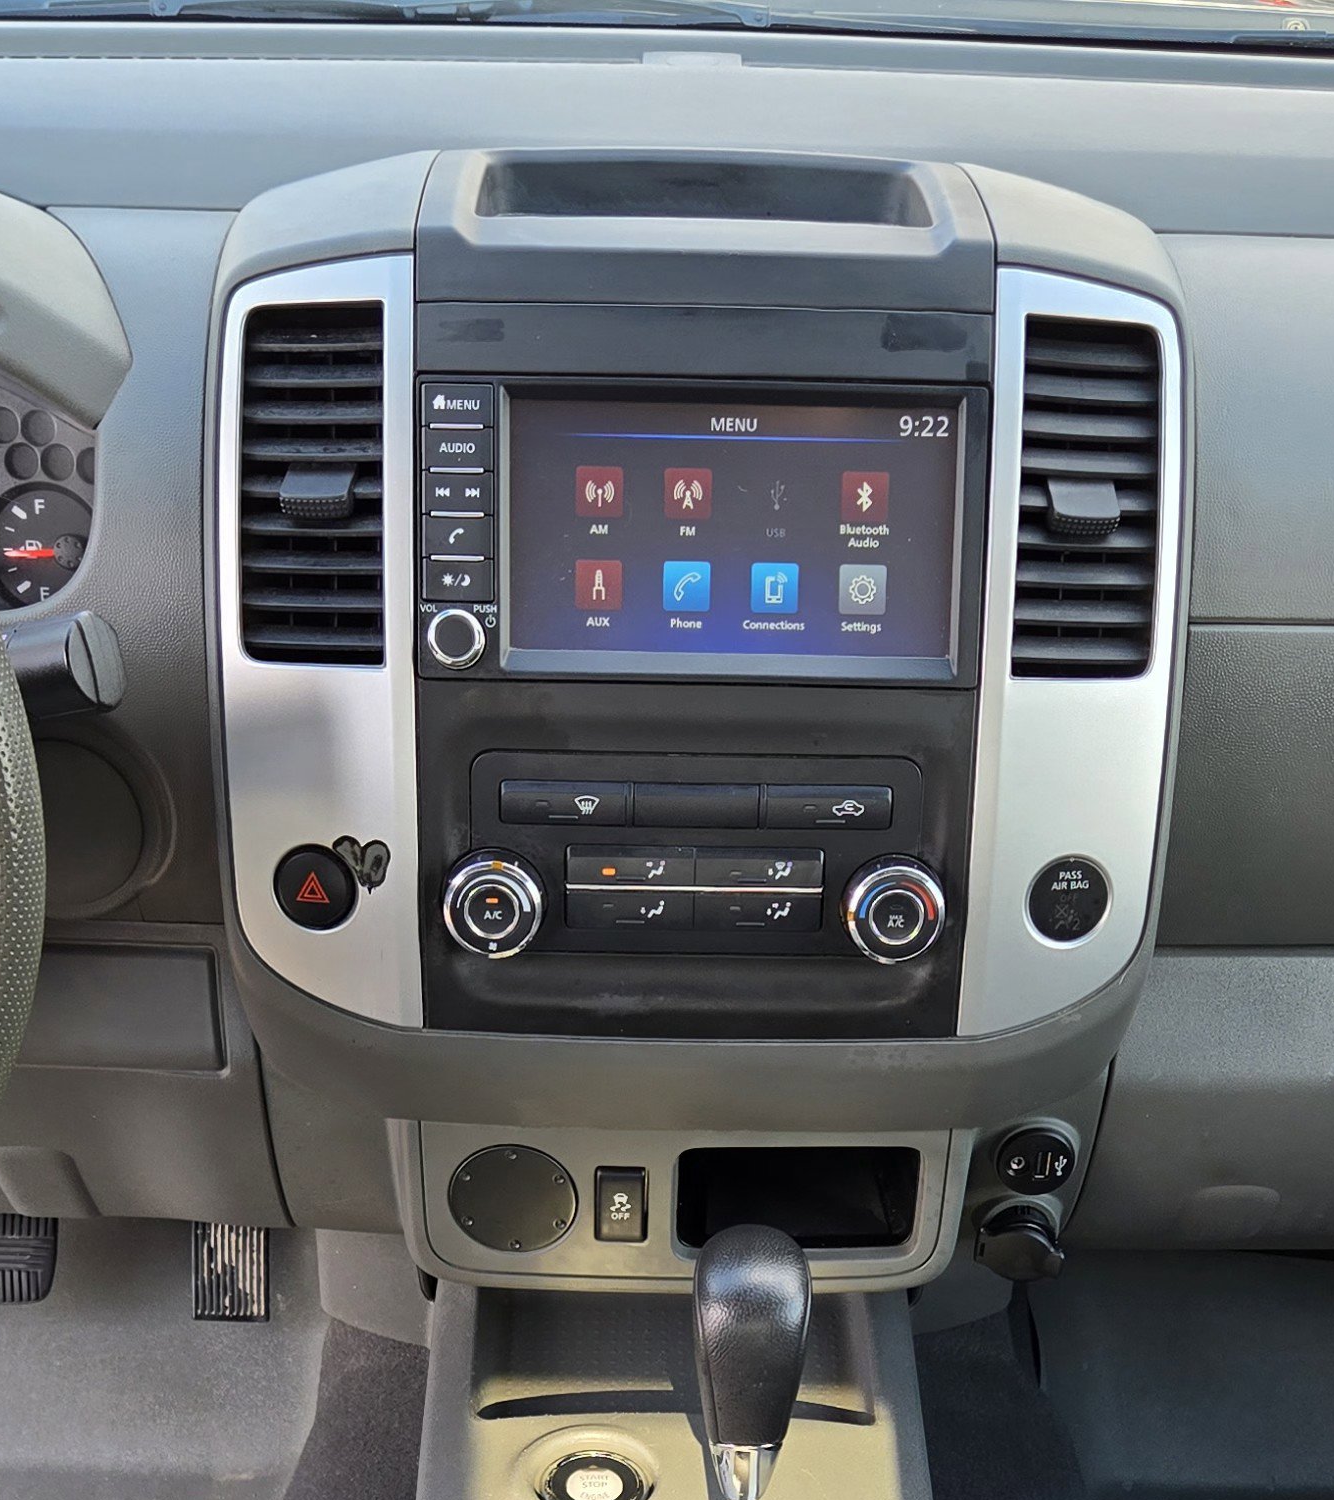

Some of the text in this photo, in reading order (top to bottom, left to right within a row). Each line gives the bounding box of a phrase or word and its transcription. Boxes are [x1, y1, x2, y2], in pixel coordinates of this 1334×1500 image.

[446, 399, 481, 410] MENU
[710, 416, 759, 432] MENU
[898, 414, 951, 439] 9:22
[439, 442, 476, 454] AUDIO
[33, 498, 46, 515] F
[589, 524, 609, 535] AM
[679, 526, 696, 537] FM
[766, 527, 787, 538] USB
[839, 524, 890, 536] Bluetooth
[848, 537, 880, 549] Audio
[419, 603, 438, 613] VOL
[473, 604, 498, 614] PUSH
[586, 616, 611, 627] AUX
[670, 617, 703, 629] Phone
[742, 619, 806, 631] Connections
[840, 620, 883, 635] Settings
[1058, 870, 1083, 880] PASS
[1050, 880, 1090, 891] AIR BAG
[484, 910, 503, 920] A/C
[887, 919, 905, 929] A/C
[610, 1212, 631, 1221] OFF
[582, 1481, 608, 1489] STOP
